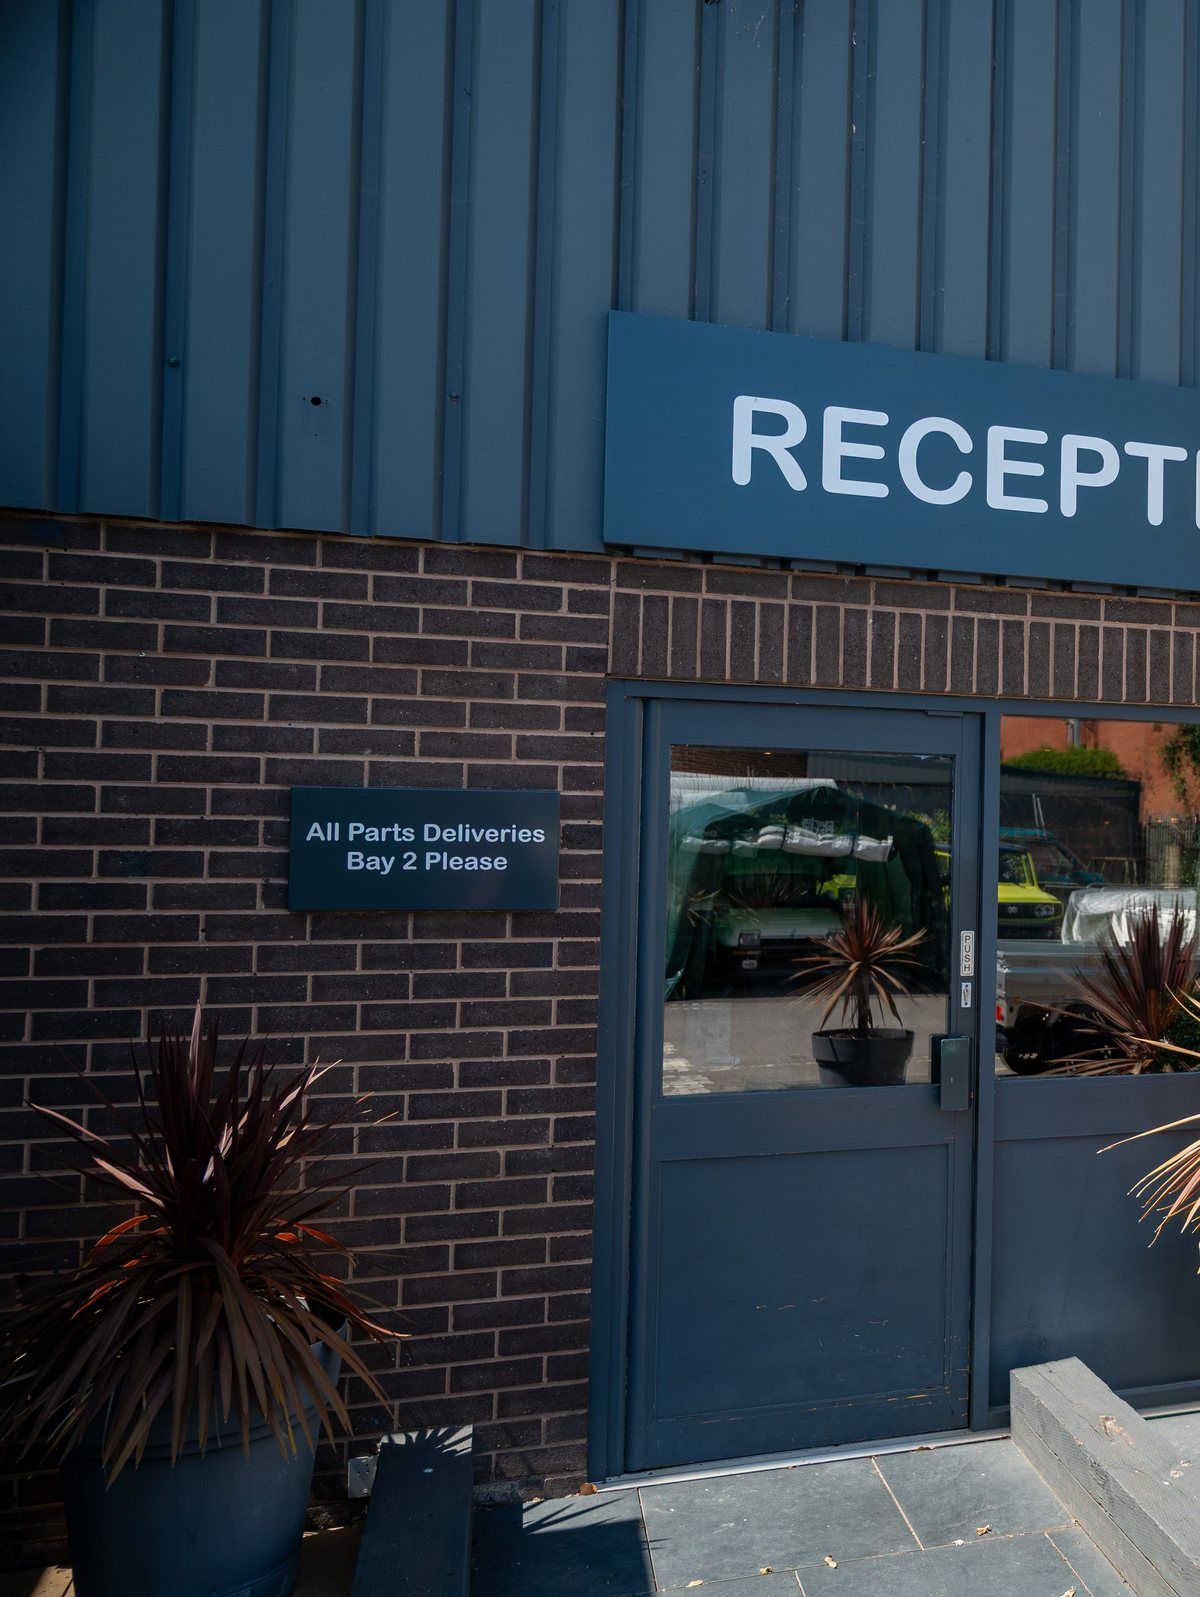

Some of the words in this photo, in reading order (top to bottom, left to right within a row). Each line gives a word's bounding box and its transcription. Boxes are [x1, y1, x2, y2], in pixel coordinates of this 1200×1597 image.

[306, 822, 340, 842] All
[348, 822, 415, 843] Parts
[423, 823, 546, 843] Deliveries
[347, 851, 396, 875] Bay
[402, 851, 417, 870] 2
[425, 851, 508, 871] Please
